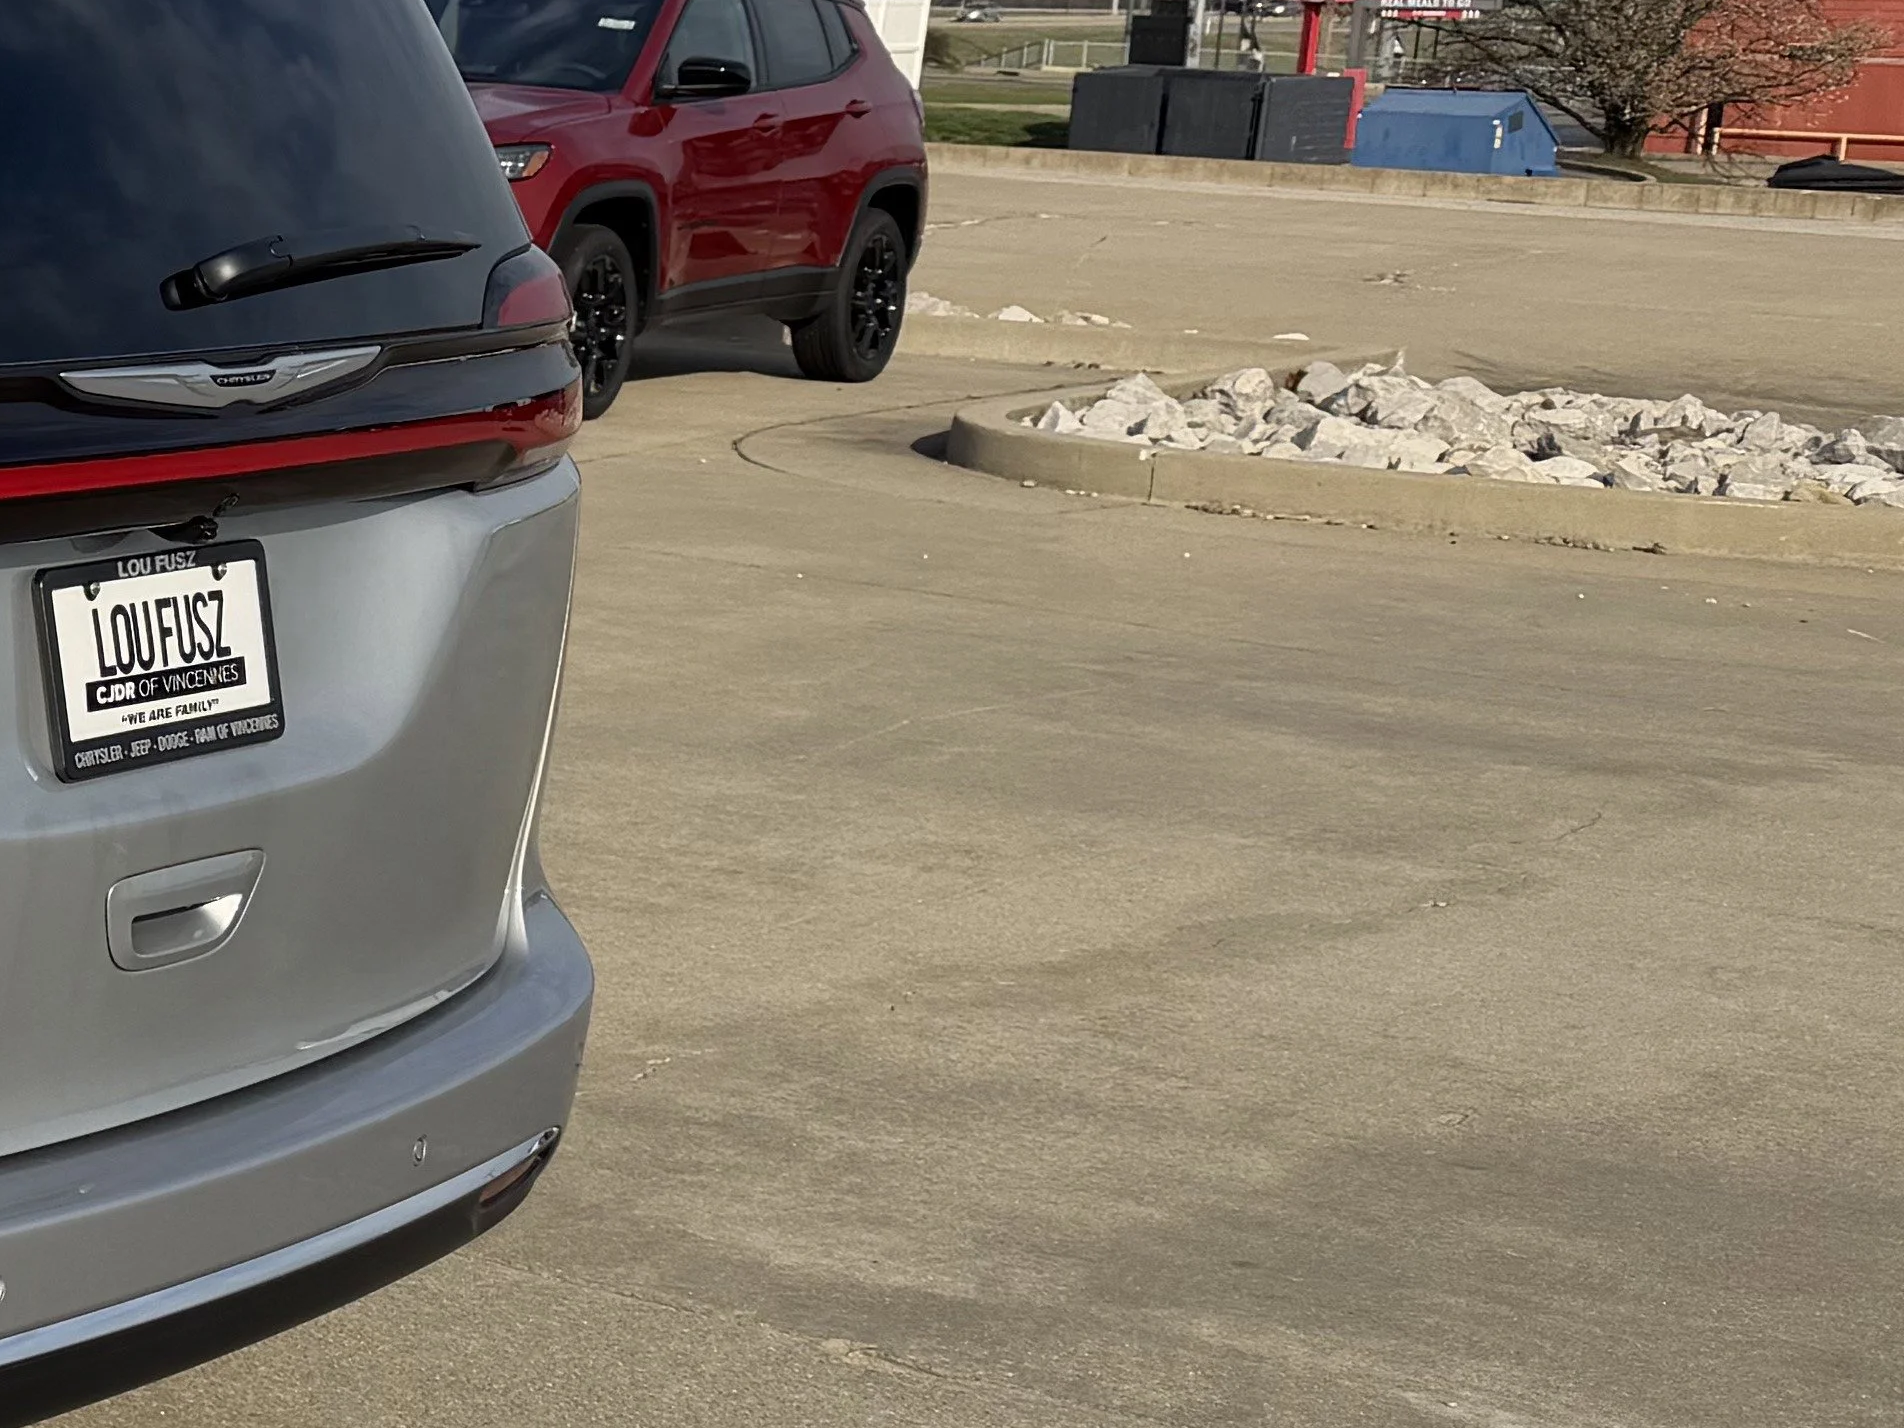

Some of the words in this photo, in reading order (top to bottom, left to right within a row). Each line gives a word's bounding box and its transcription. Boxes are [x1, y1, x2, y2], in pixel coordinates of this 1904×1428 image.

[117, 556, 151, 578] LOU
[154, 551, 197, 573] FUSZ
[96, 681, 136, 704] CJDR
[138, 677, 159, 697] OF
[161, 663, 239, 693] VINCENNES
[148, 706, 172, 723] ARE
[129, 738, 152, 758] JEEP
[157, 730, 191, 752] DODGE
